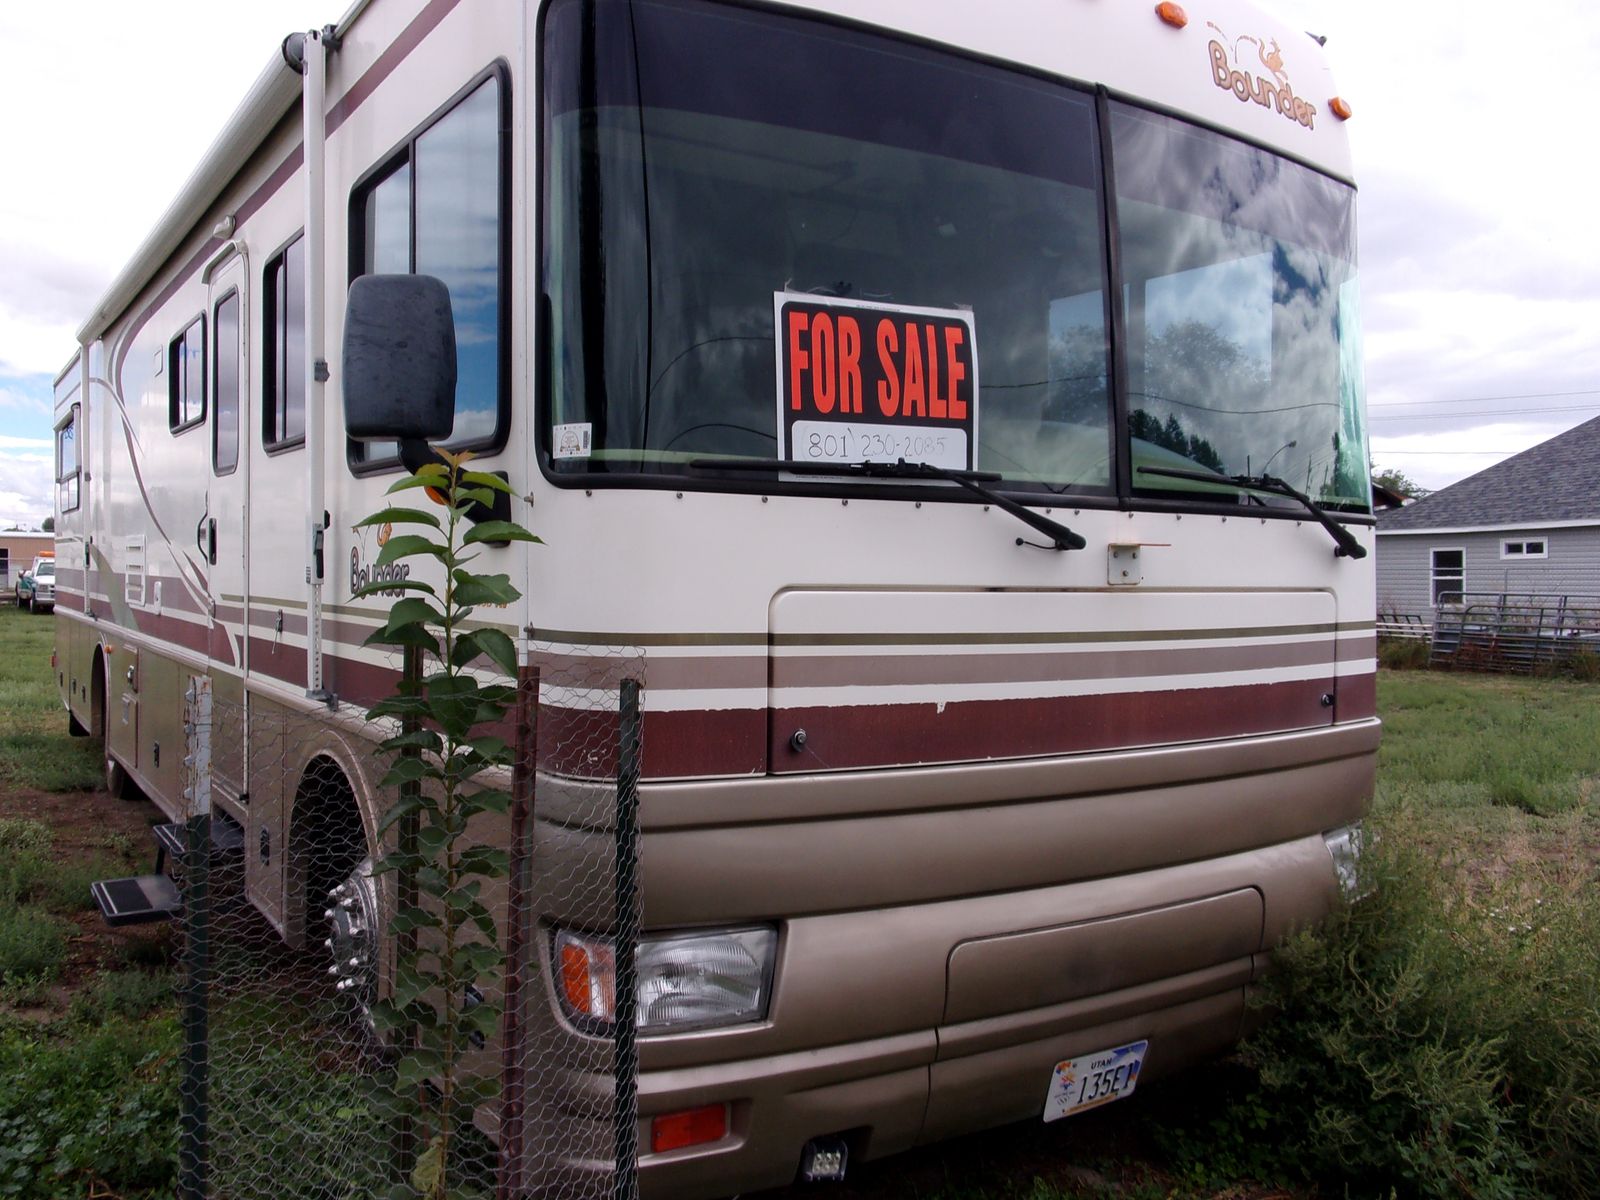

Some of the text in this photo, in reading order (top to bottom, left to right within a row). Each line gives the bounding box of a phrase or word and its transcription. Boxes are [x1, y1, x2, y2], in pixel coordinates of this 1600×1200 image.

[1208, 39, 1316, 131] Bounder
[789, 311, 966, 419] FOR SALE
